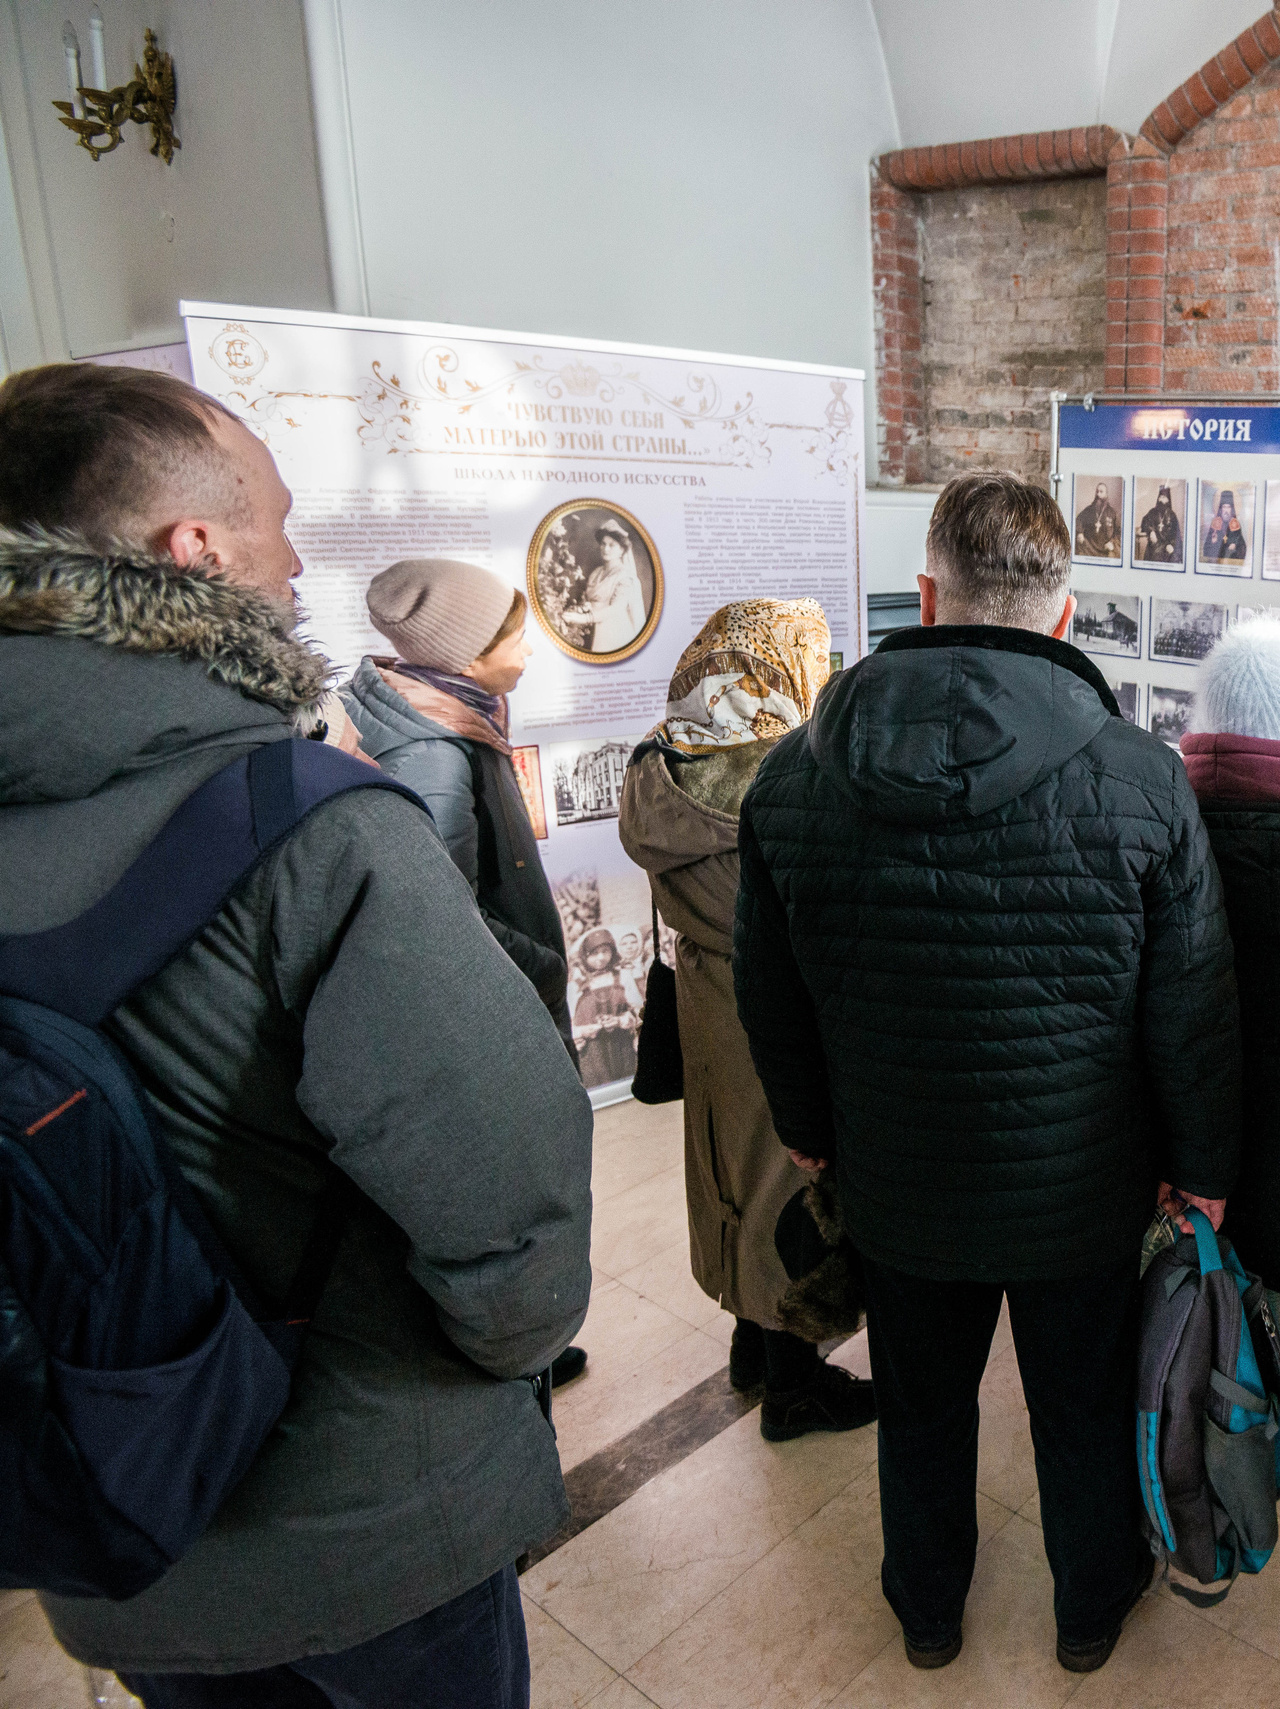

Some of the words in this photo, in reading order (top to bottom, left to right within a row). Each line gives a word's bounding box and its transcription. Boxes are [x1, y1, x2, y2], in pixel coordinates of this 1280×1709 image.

[621, 410, 664, 429] СЕБЯ
[1142, 416, 1252, 443] ИСТОРИЯ
[444, 426, 547, 449] МАТЕРЬЮ
[555, 430, 604, 452] ЭТОЙ
[454, 467, 516, 482] ШКОЛА
[521, 469, 620, 485] НАРОДНОГО
[624, 472, 707, 488] ИСКУССТВА
